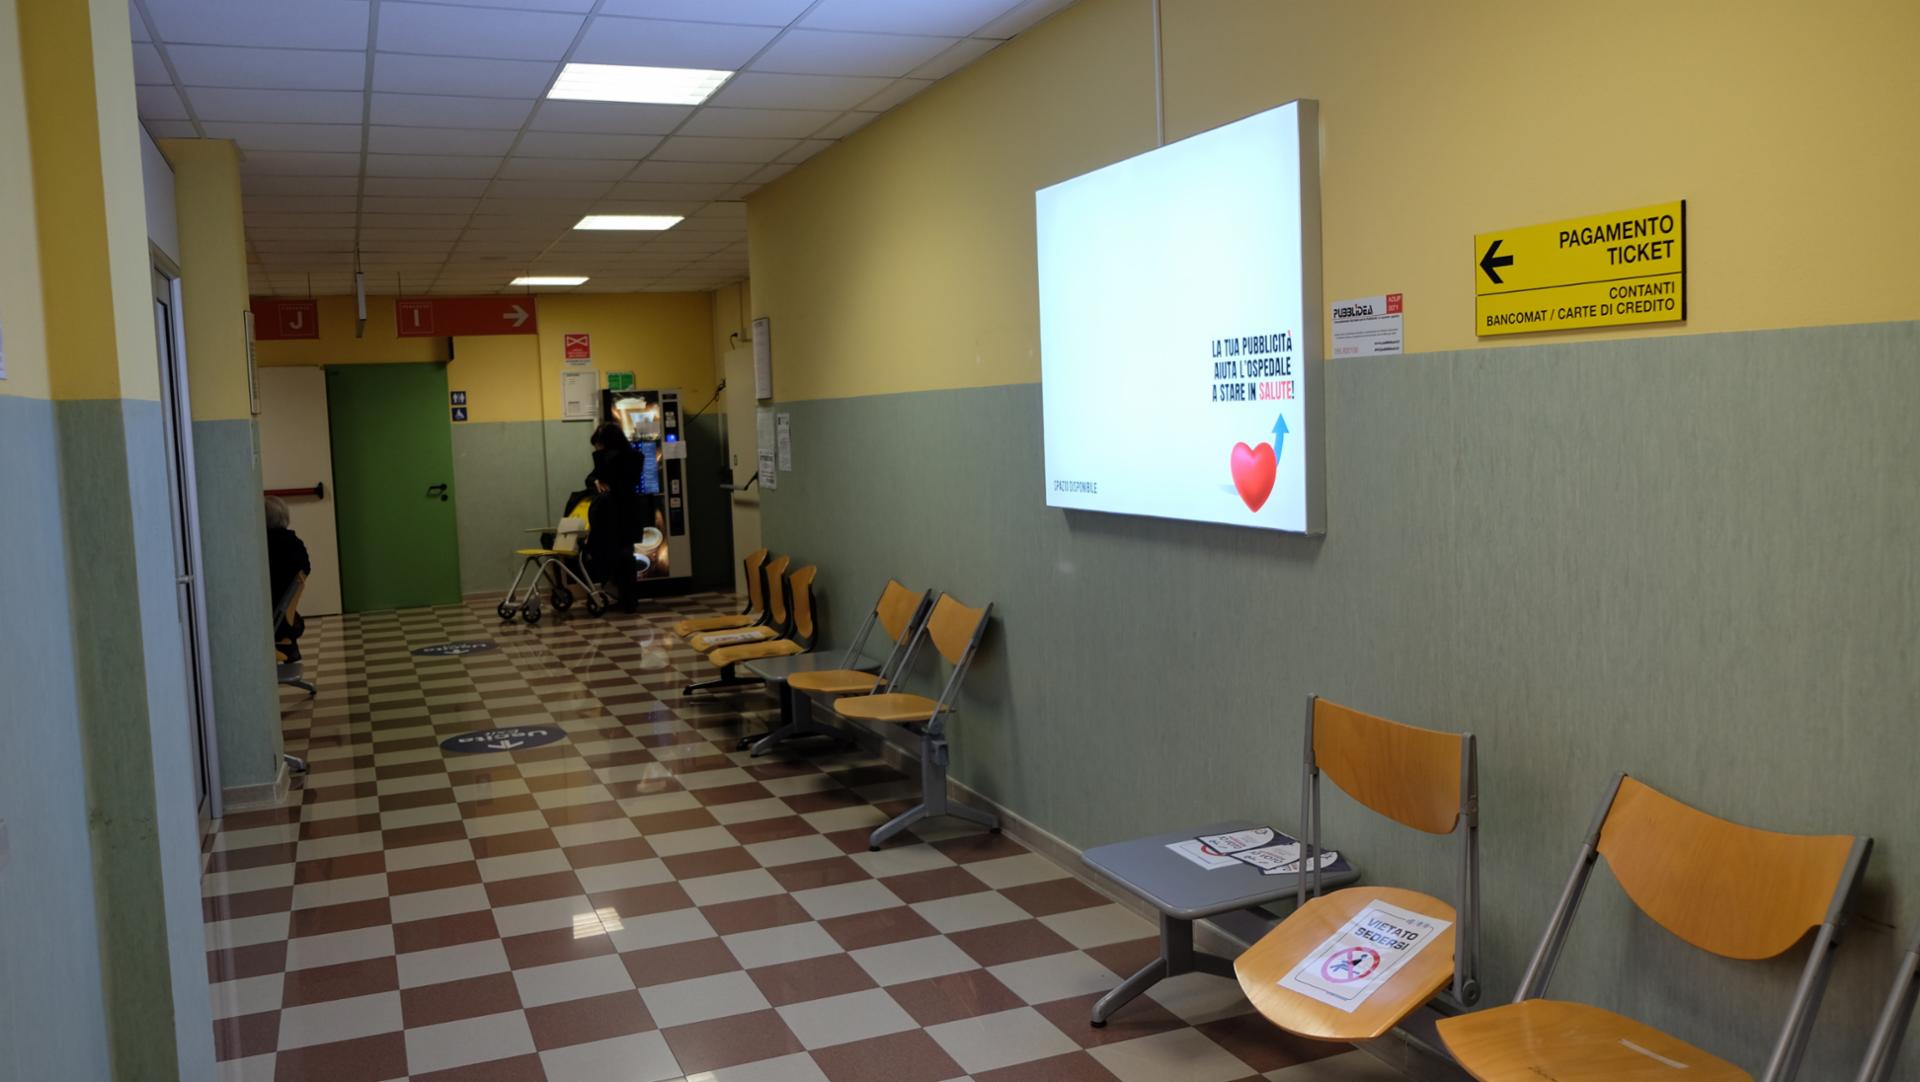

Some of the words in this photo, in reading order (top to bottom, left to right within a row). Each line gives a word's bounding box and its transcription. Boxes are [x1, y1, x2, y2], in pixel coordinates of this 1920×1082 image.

[1559, 214, 1674, 249] PAGAMENTO
[1607, 239, 1675, 265] TICKET
[1609, 281, 1675, 299] CONTANTI
[289, 311, 303, 330] J
[1486, 309, 1547, 327] BANCOMAT
[1550, 309, 1555, 321] /
[1557, 305, 1597, 320] CARTE
[1601, 303, 1613, 316] DI
[1616, 298, 1675, 315] CREDITO
[1212, 340, 1222, 358] LA
[1224, 338, 1240, 357] TUA
[1242, 330, 1292, 355] PUBBLICITÀ
[1215, 361, 1237, 379] AIUTA
[1240, 356, 1291, 378] L'OSPEDALE
[1212, 384, 1217, 402] A
[1220, 383, 1246, 401] STARE
[1247, 382, 1257, 401] IN
[1259, 380, 1295, 400] SALUTE!
[1354, 927, 1410, 951] SEDERSI
[1367, 917, 1419, 941] VIETATO
